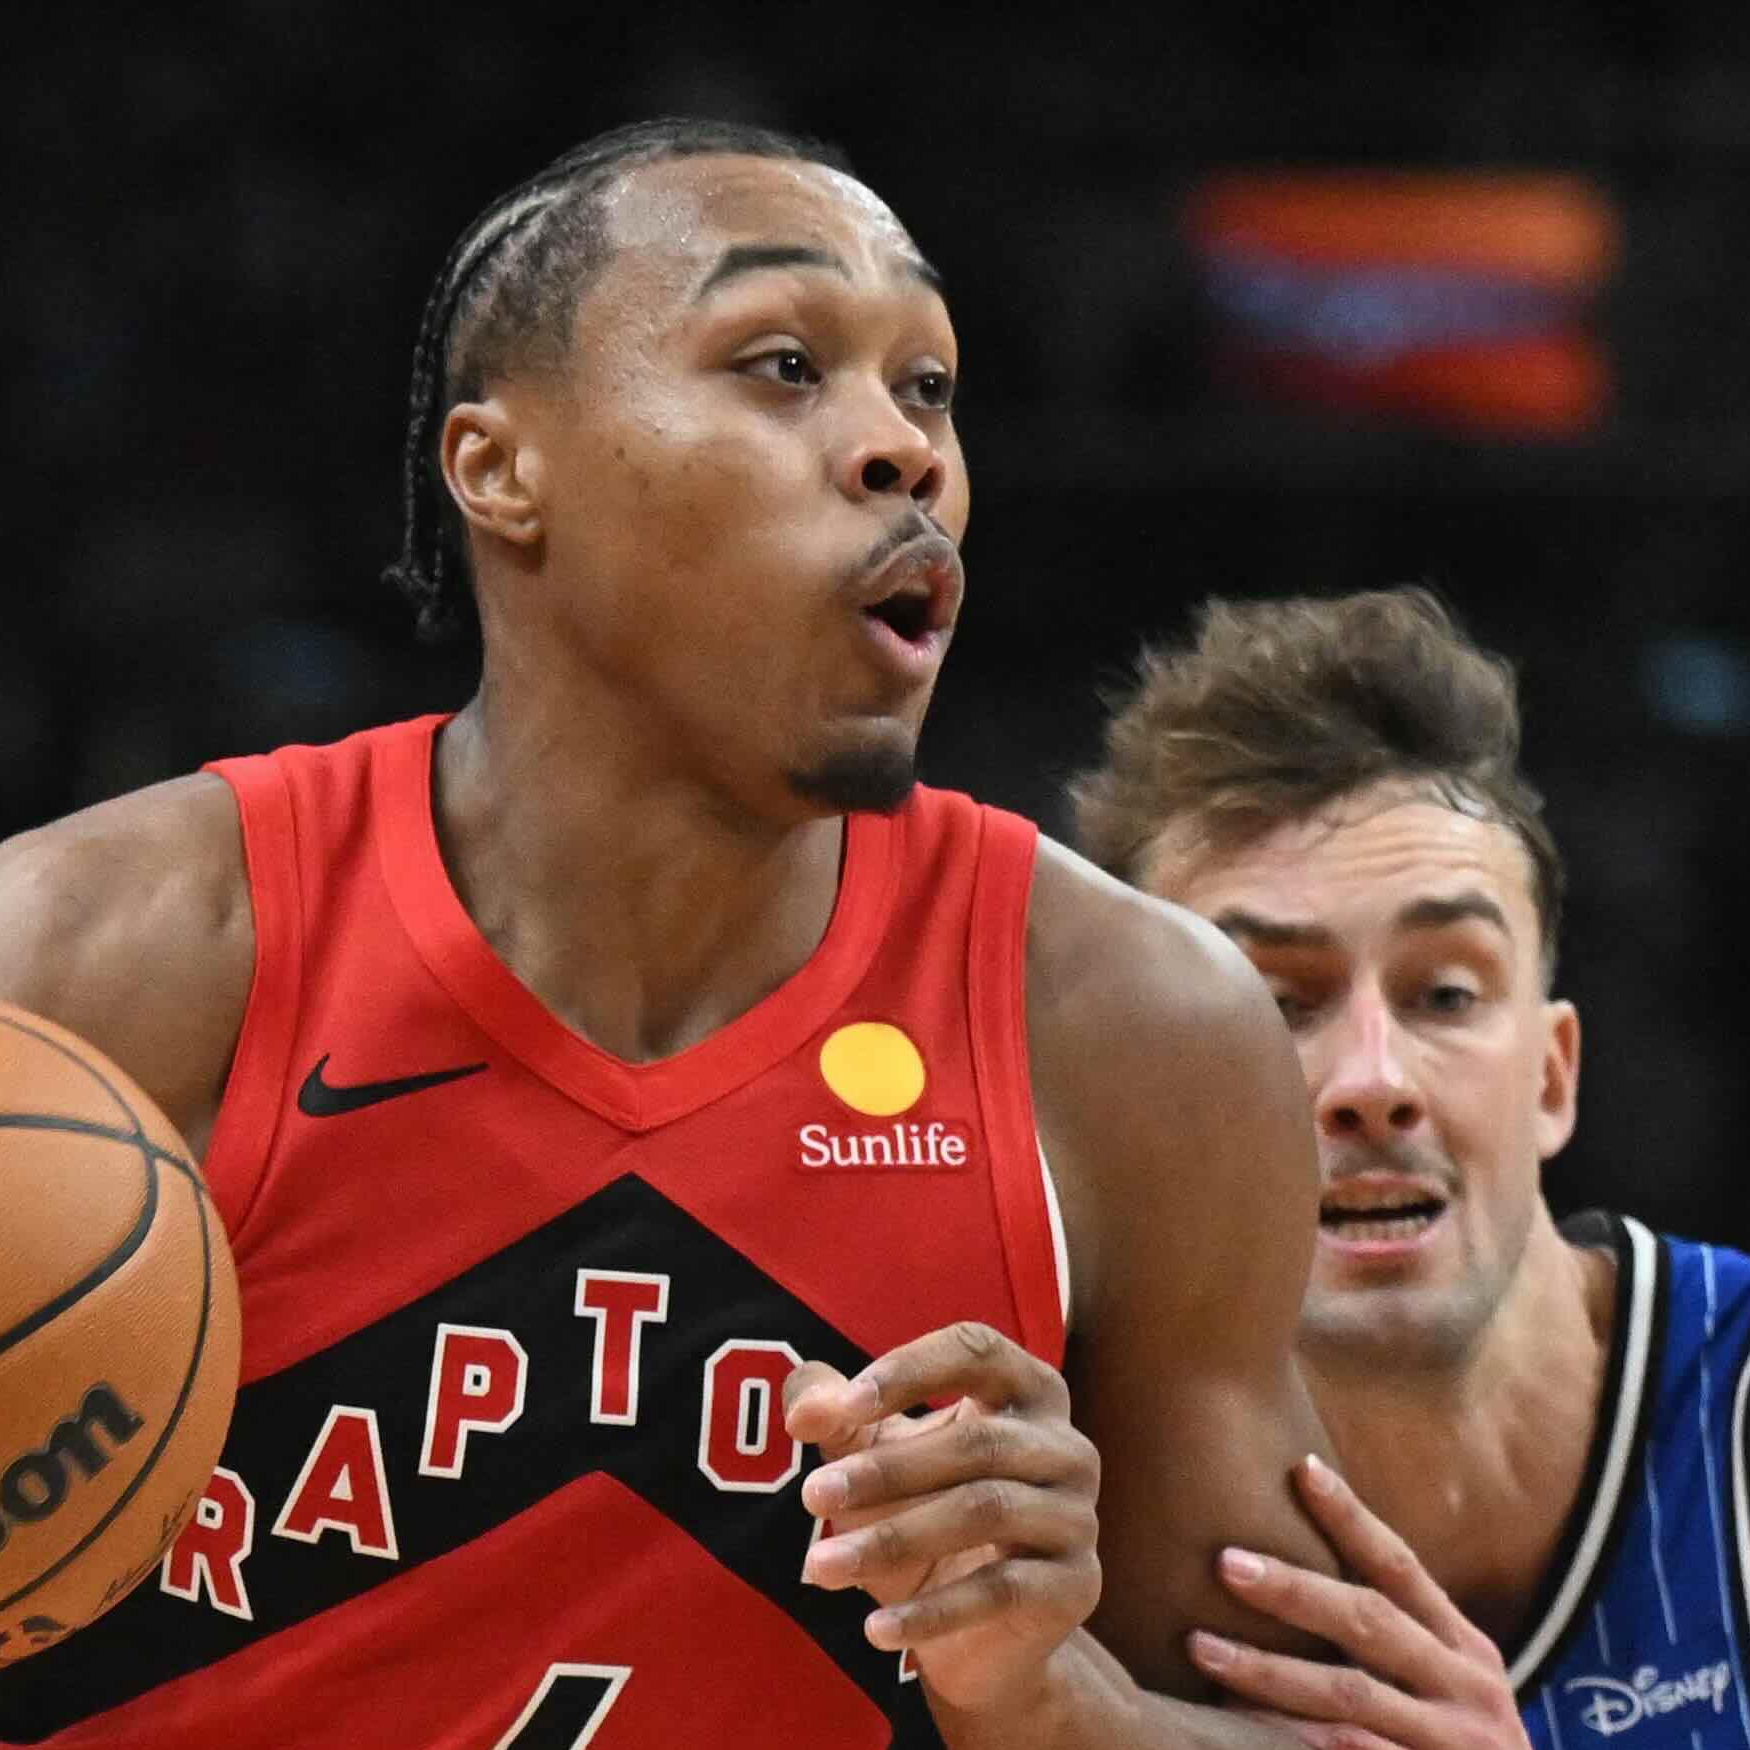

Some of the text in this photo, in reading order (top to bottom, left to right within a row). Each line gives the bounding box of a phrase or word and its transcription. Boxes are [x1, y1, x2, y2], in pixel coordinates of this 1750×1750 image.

[798, 1121, 967, 1168] Sunlife
[159, 1267, 918, 1684] RAPTO
[1564, 1660, 1731, 1737] Disney
